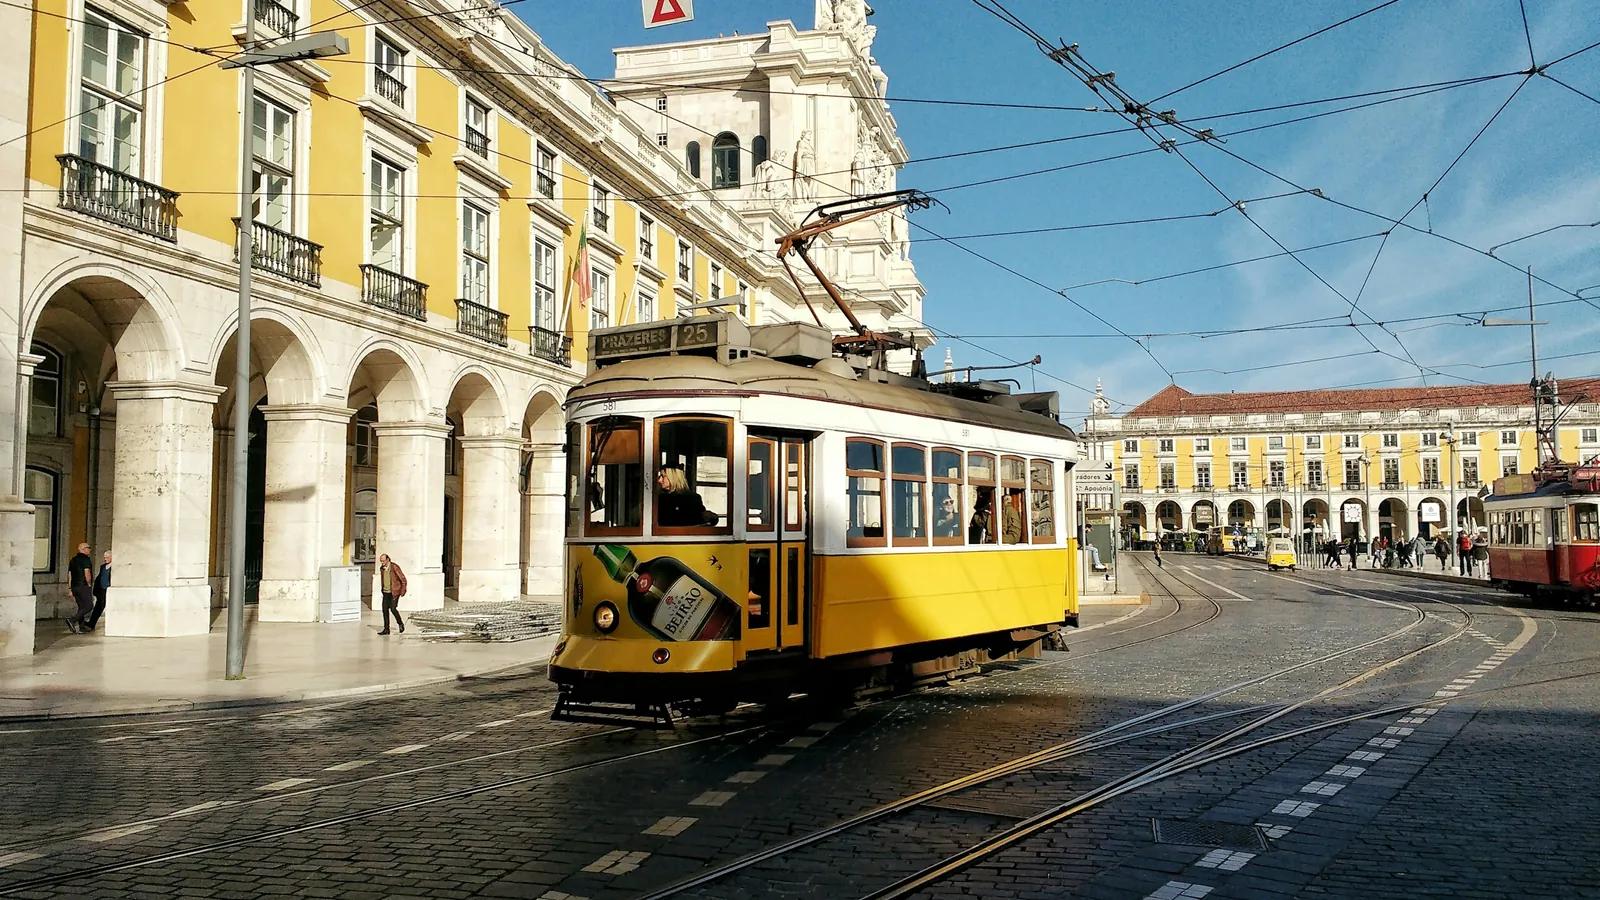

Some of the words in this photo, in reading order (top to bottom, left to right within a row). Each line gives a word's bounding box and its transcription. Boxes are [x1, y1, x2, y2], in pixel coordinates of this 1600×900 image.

[601, 330, 666, 348] PRAZERES
[684, 324, 708, 343] 25
[603, 401, 617, 411] 581
[664, 588, 701, 634] BEIRÃO
